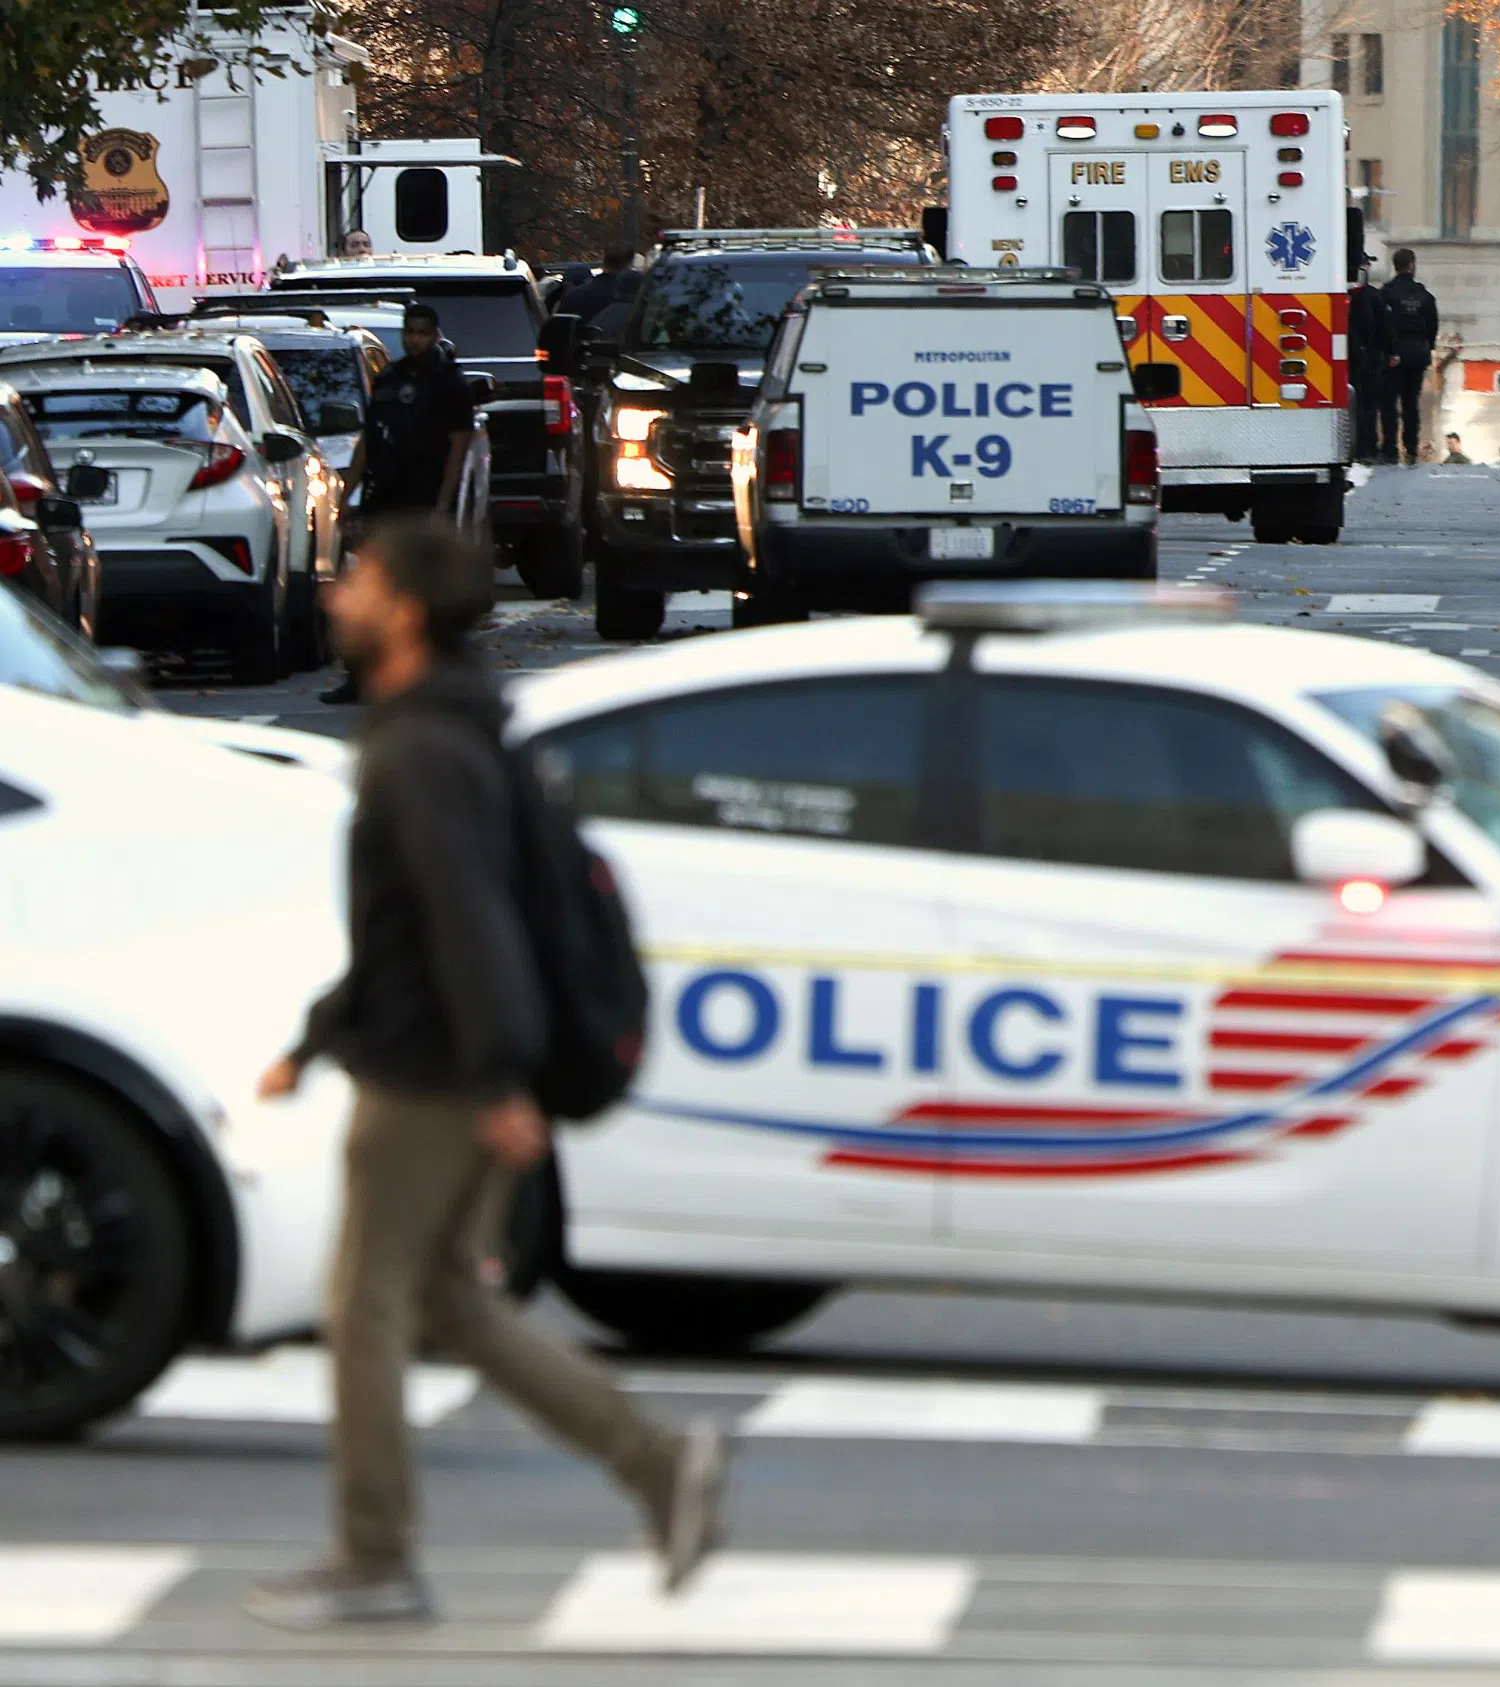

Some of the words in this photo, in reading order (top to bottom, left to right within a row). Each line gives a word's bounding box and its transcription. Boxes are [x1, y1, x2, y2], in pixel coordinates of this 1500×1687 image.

[1072, 162, 1125, 184] FIRE
[1170, 160, 1221, 183] EMS
[914, 351, 1011, 362] METROPOLITAN
[850, 381, 1073, 418] POLICE
[911, 434, 1012, 478] K-9
[676, 970, 1184, 1088] OLICE
